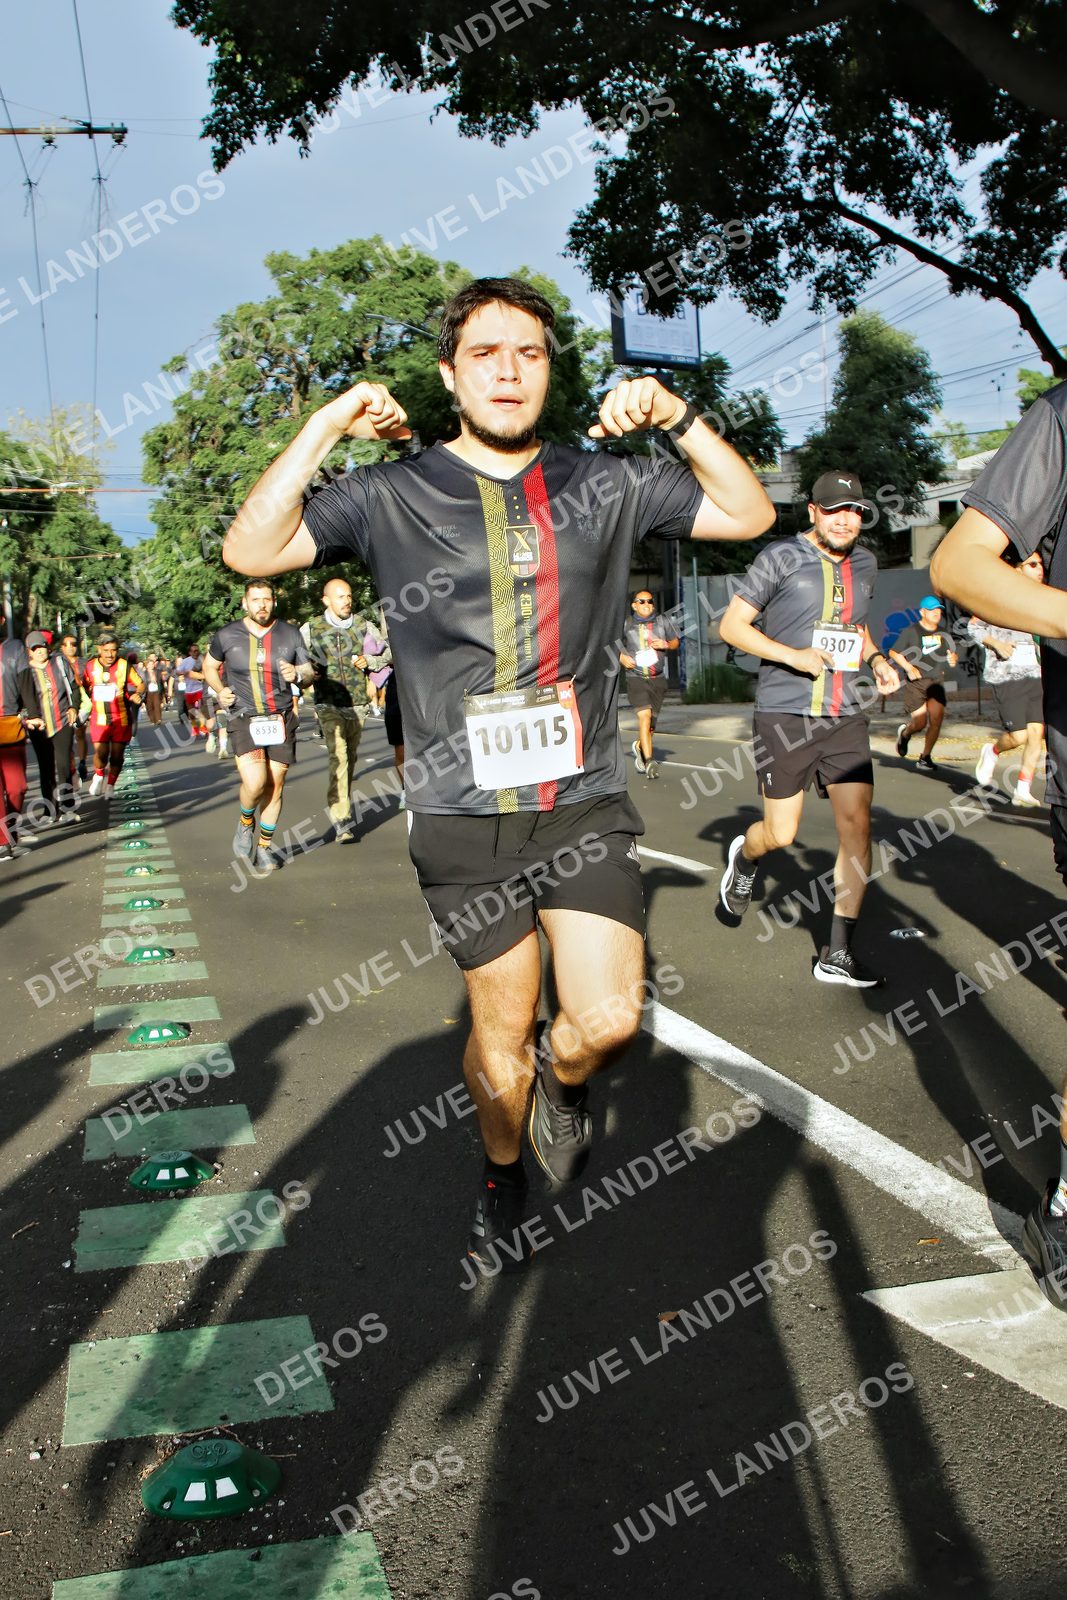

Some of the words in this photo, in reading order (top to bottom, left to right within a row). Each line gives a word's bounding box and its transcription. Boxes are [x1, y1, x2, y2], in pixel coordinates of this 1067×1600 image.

[820, 637, 855, 653] 9307
[255, 725, 278, 736] 8538
[475, 715, 568, 756] 10115
